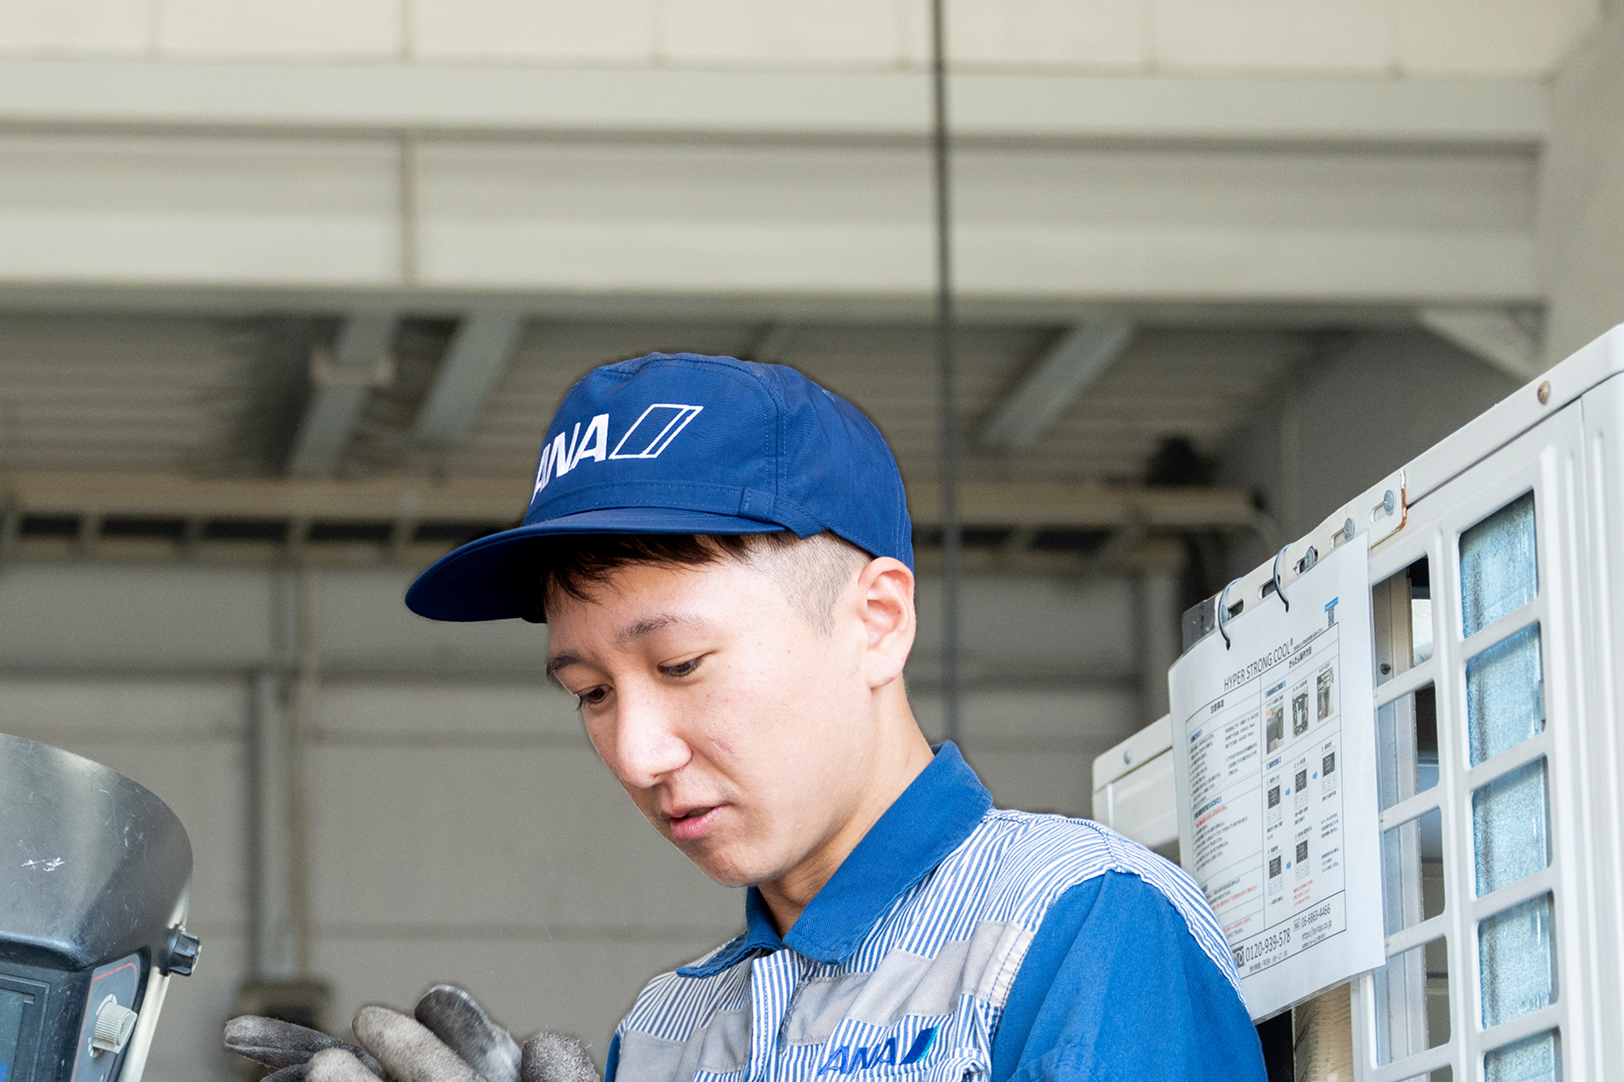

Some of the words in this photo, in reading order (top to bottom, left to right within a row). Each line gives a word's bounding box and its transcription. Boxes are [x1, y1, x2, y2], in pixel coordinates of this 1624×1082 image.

[530, 413, 610, 505] ANA
[1224, 668, 1245, 692] HYPER
[1246, 652, 1273, 680] STRONG
[1245, 927, 1291, 962] 0120-939-578
[817, 1036, 897, 1076] ANA
